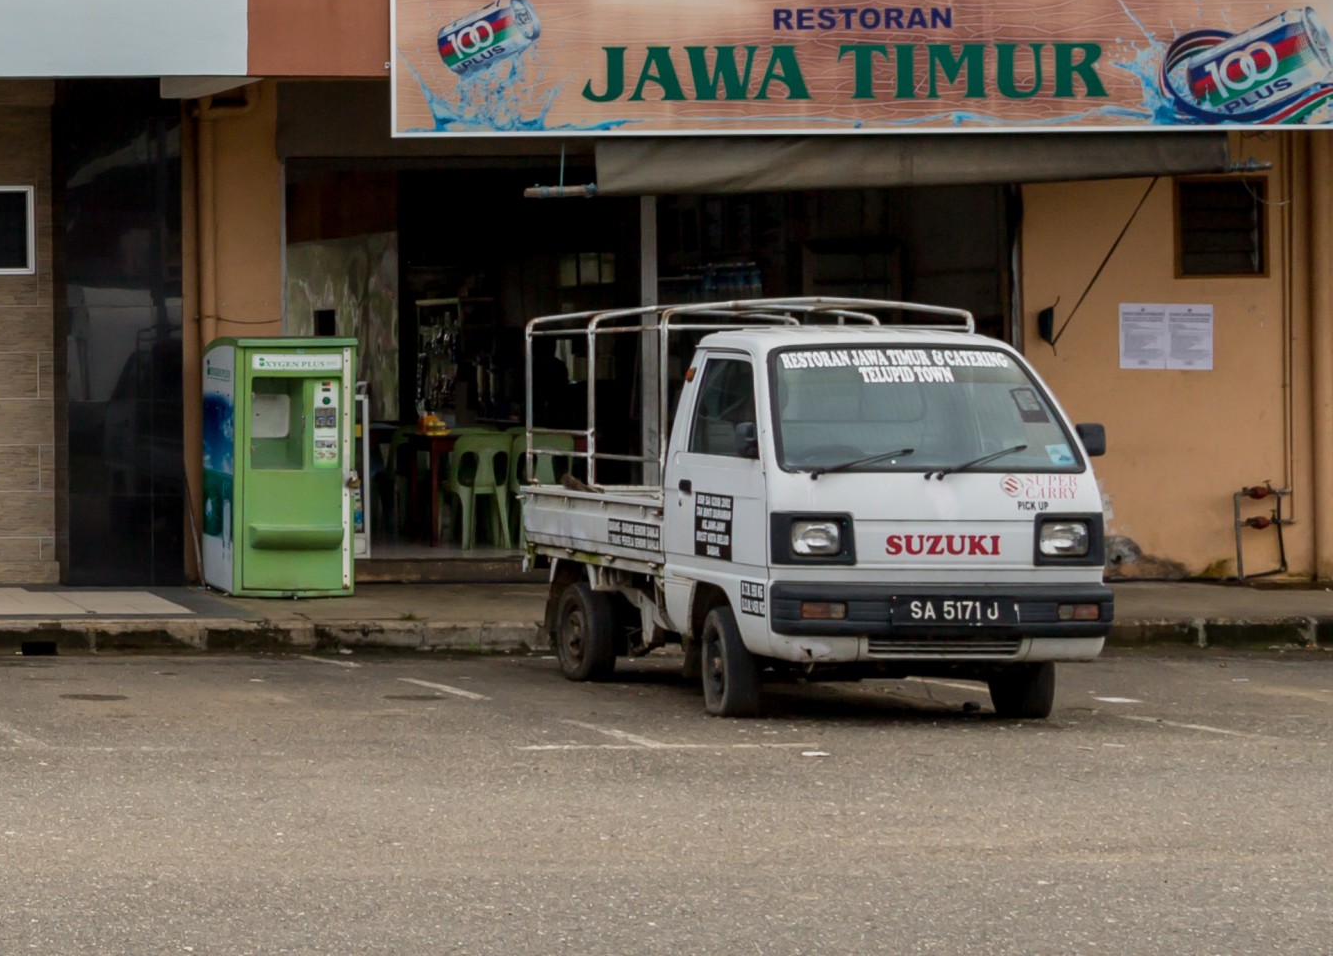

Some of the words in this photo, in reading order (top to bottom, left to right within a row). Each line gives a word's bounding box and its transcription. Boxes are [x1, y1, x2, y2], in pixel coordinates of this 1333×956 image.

[772, 7, 953, 31] RESTORAN
[447, 20, 495, 59] 100
[461, 45, 506, 71] PLUS
[581, 45, 813, 102] JAWA
[836, 41, 1110, 100] TIMUR
[1204, 41, 1279, 99] 100
[1223, 77, 1293, 114] PLUS
[780, 350, 852, 369] RESTORAN
[851, 349, 887, 368] JAWA
[886, 349, 930, 366] TIMUR
[932, 350, 944, 365] &
[944, 349, 1008, 368] CATERING
[858, 366, 915, 383] TELUPID
[914, 367, 954, 383] TOWN
[1025, 475, 1078, 487] SUPER
[1025, 487, 1077, 499] CARRY
[1017, 501, 1037, 510] PICK
[1039, 501, 1049, 510] UP
[885, 535, 1001, 555] SUZUKI
[910, 600, 936, 619] SA
[943, 601, 982, 619] 5171
[987, 602, 998, 619] J
